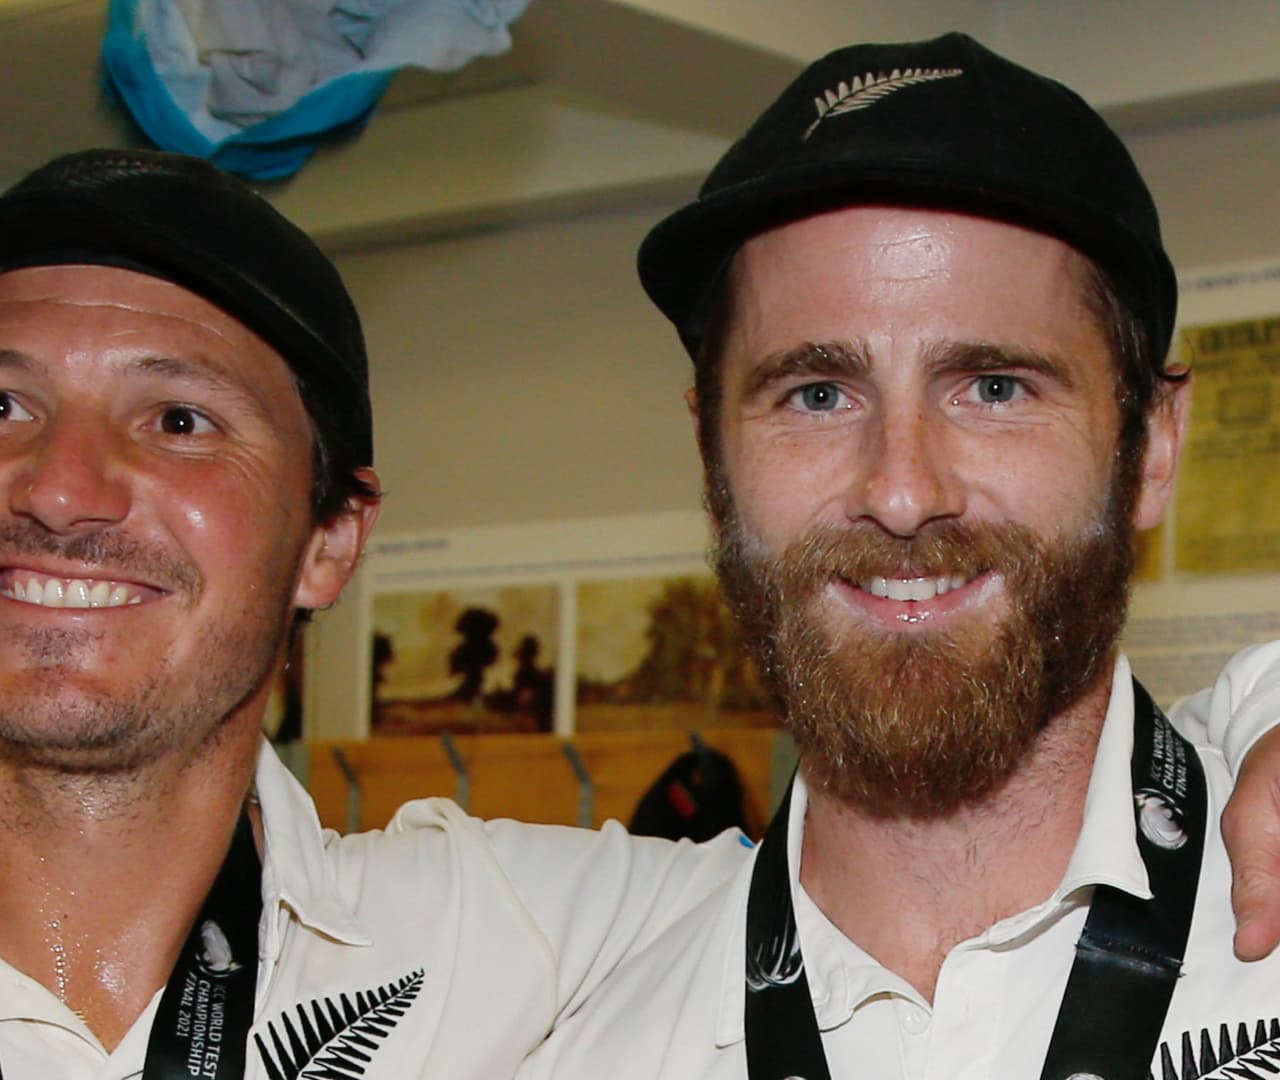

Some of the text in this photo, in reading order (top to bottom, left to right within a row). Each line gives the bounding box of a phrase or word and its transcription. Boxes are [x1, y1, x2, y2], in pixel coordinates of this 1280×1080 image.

[1175, 763, 1187, 798] FINAL
[176, 970, 198, 1037] FINAL 2021
[207, 1002, 225, 1042] WORLD
[187, 979, 211, 1077] CHAMPIONSHIP
[202, 1045, 221, 1080] TEST
